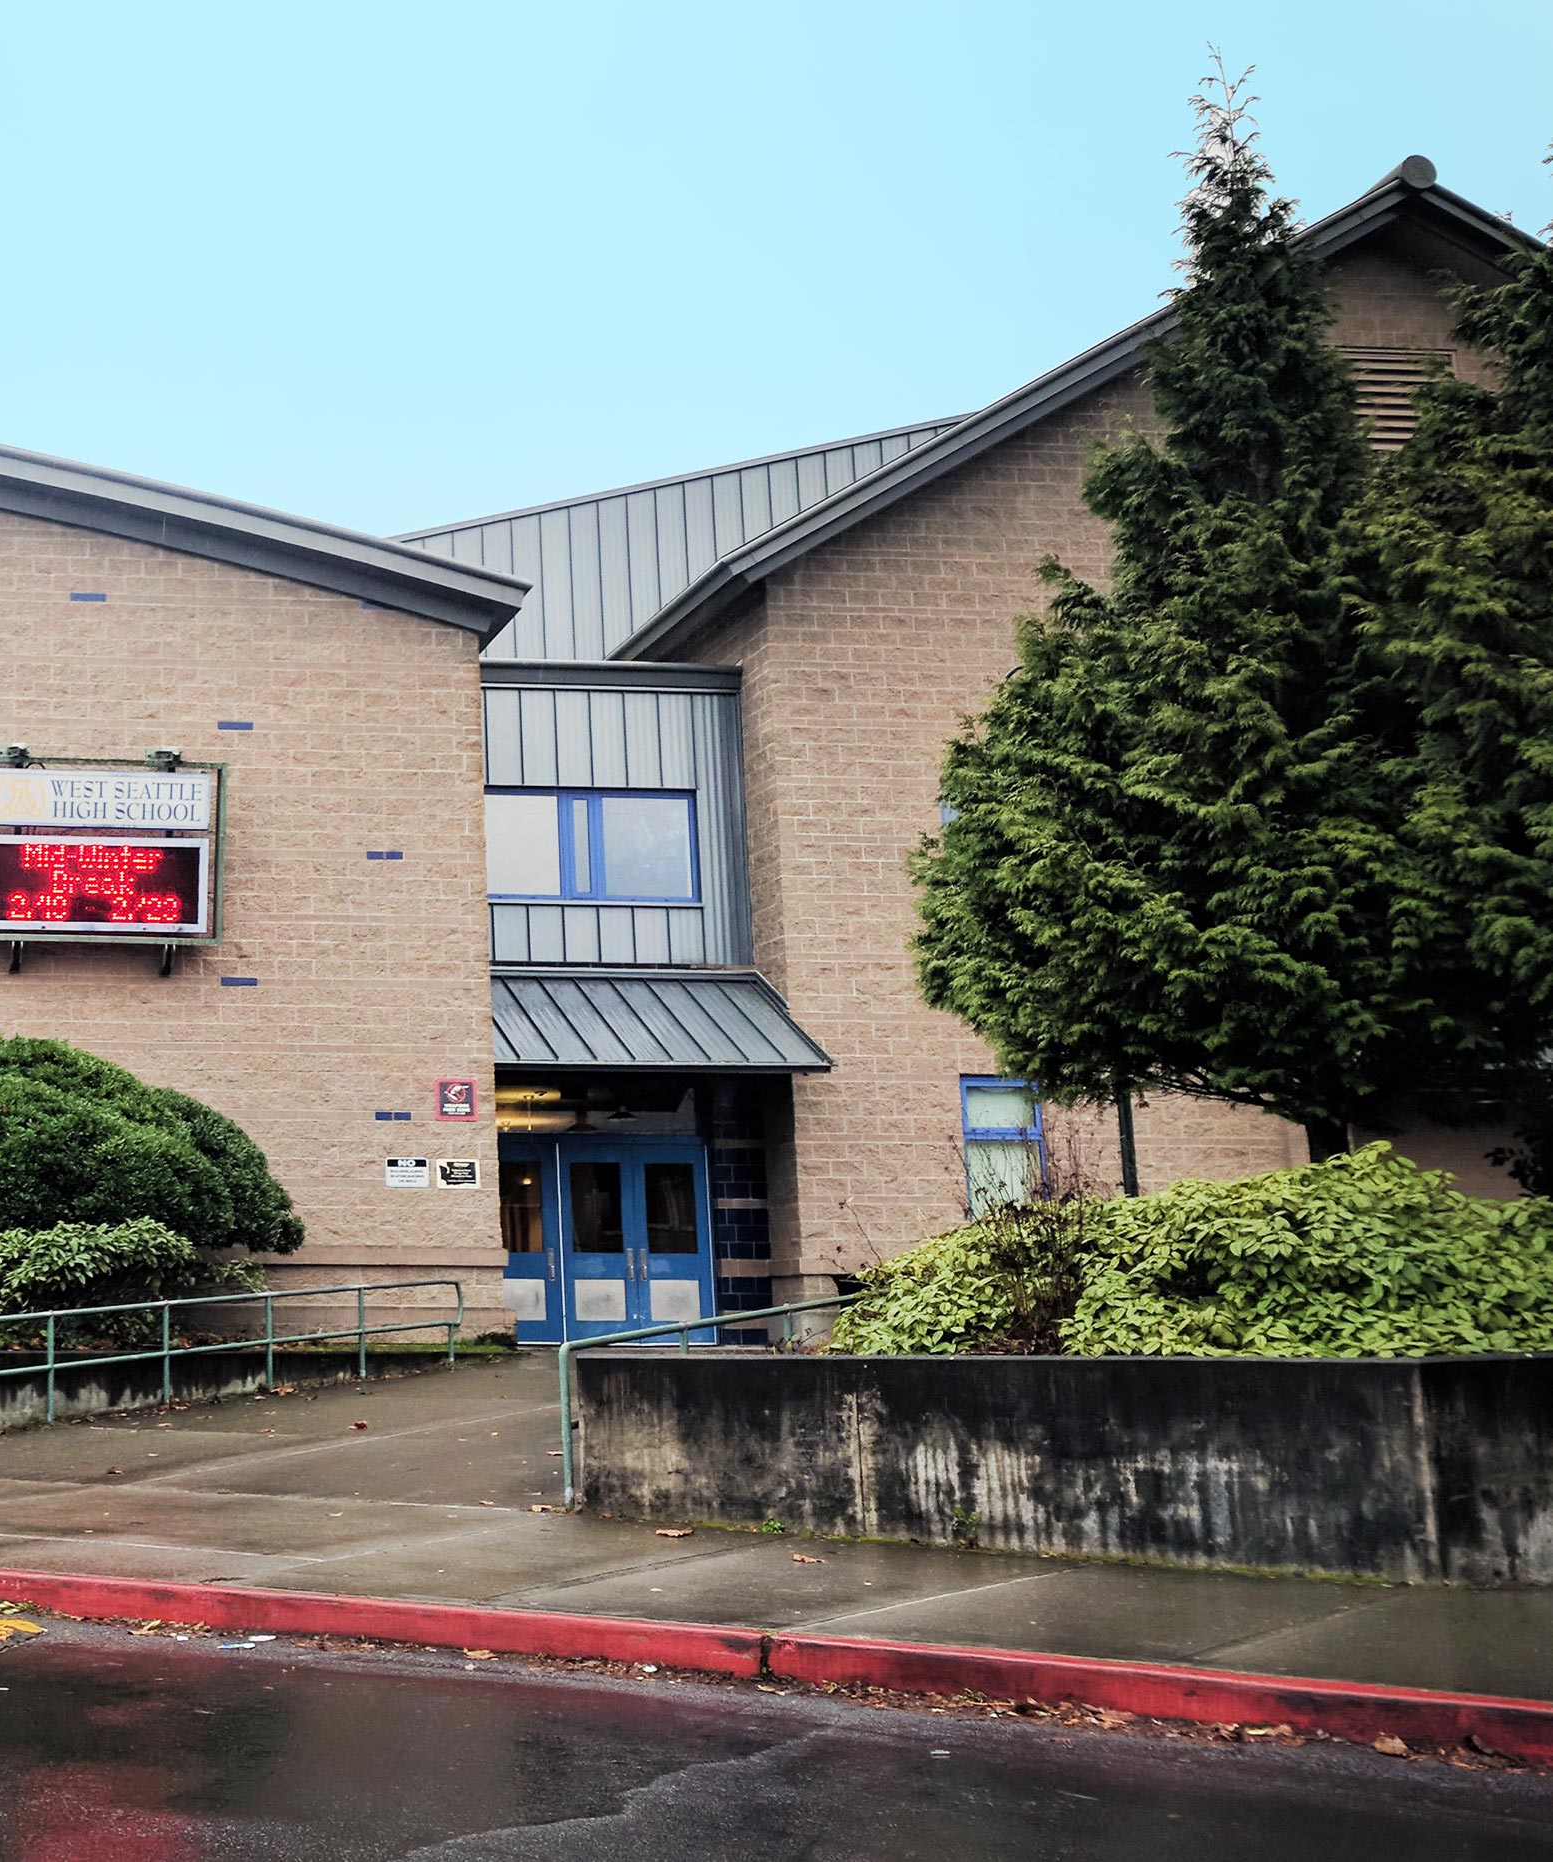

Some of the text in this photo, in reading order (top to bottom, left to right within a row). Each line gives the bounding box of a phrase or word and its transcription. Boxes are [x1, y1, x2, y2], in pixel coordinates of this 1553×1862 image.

[51, 780, 202, 801] WEST SEATTLE
[53, 801, 201, 822] HIGH SCHOOL
[51, 870, 135, 895] Break
[398, 1159, 416, 1167] NO
